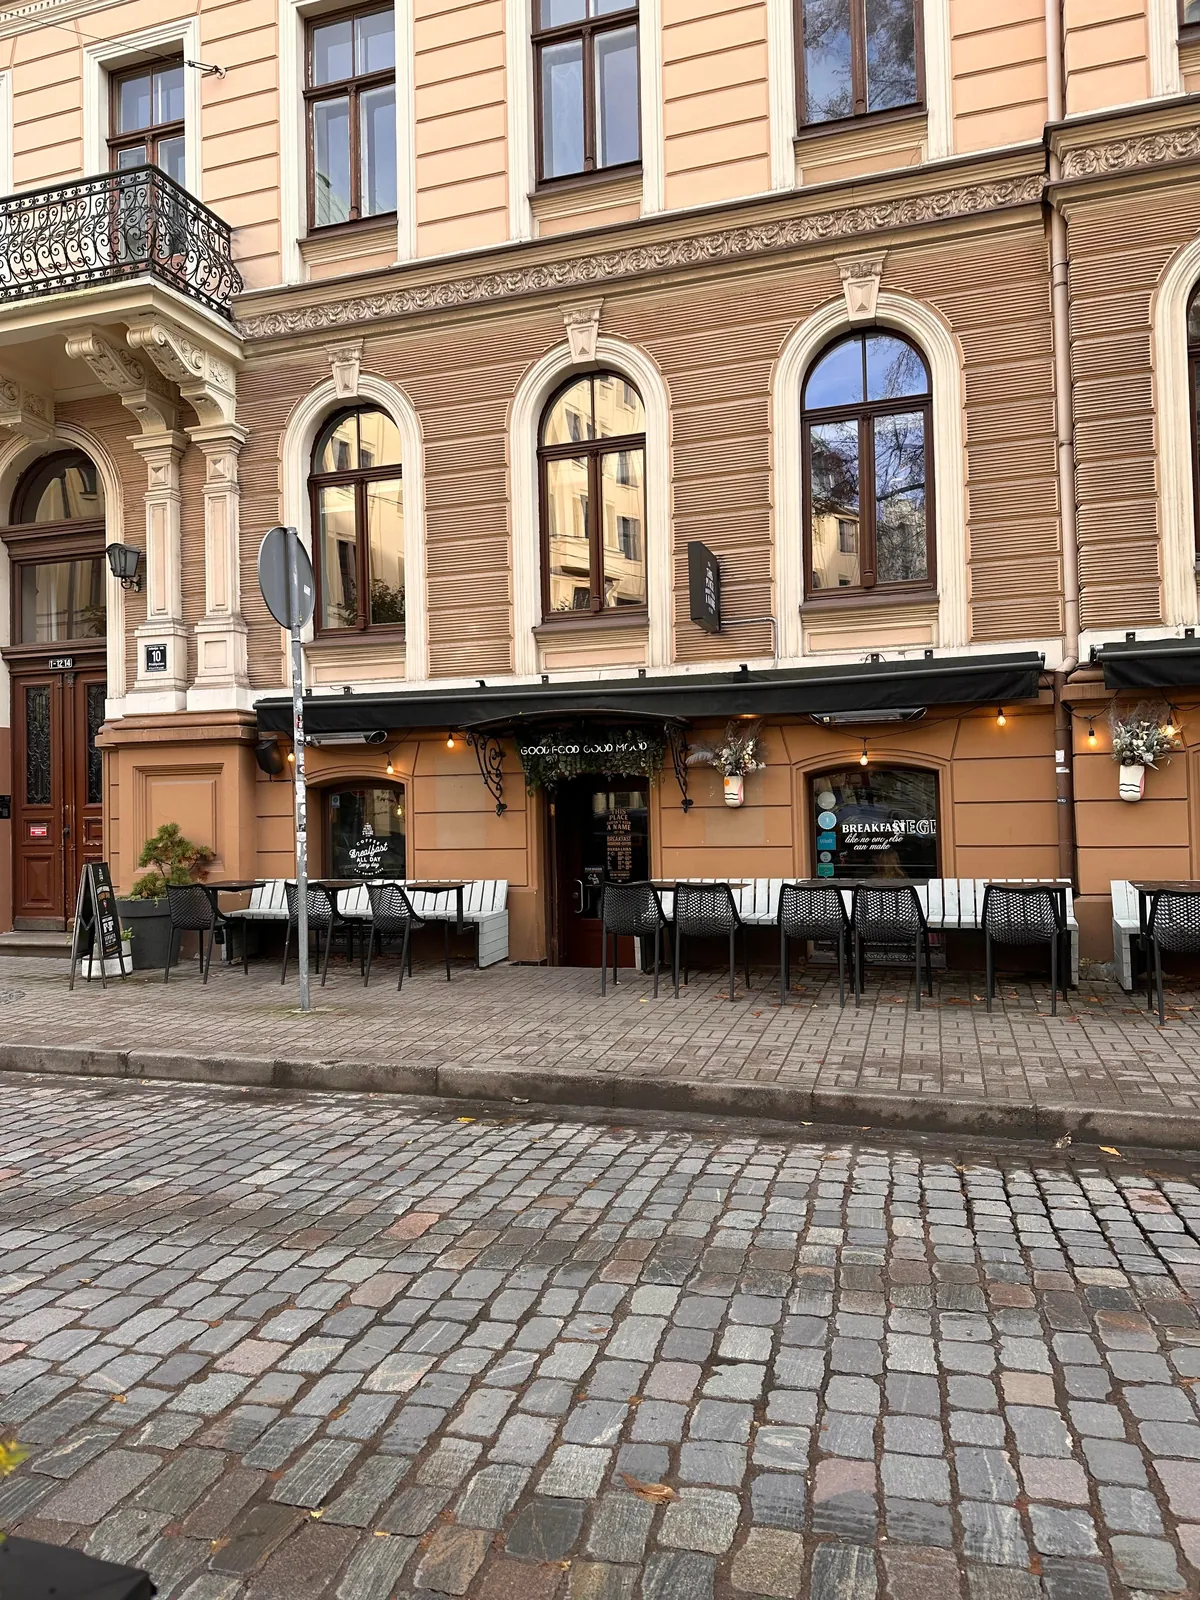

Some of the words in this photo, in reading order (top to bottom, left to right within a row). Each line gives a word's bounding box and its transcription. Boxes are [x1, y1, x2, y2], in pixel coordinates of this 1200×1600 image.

[152, 650, 161, 662] 10
[520, 745, 549, 755] GOOD
[551, 744, 580, 754] FOOD
[843, 824, 907, 834] BREAKFAST
[845, 833, 859, 843] like
[888, 834, 904, 843] else
[869, 839, 891, 850] make
